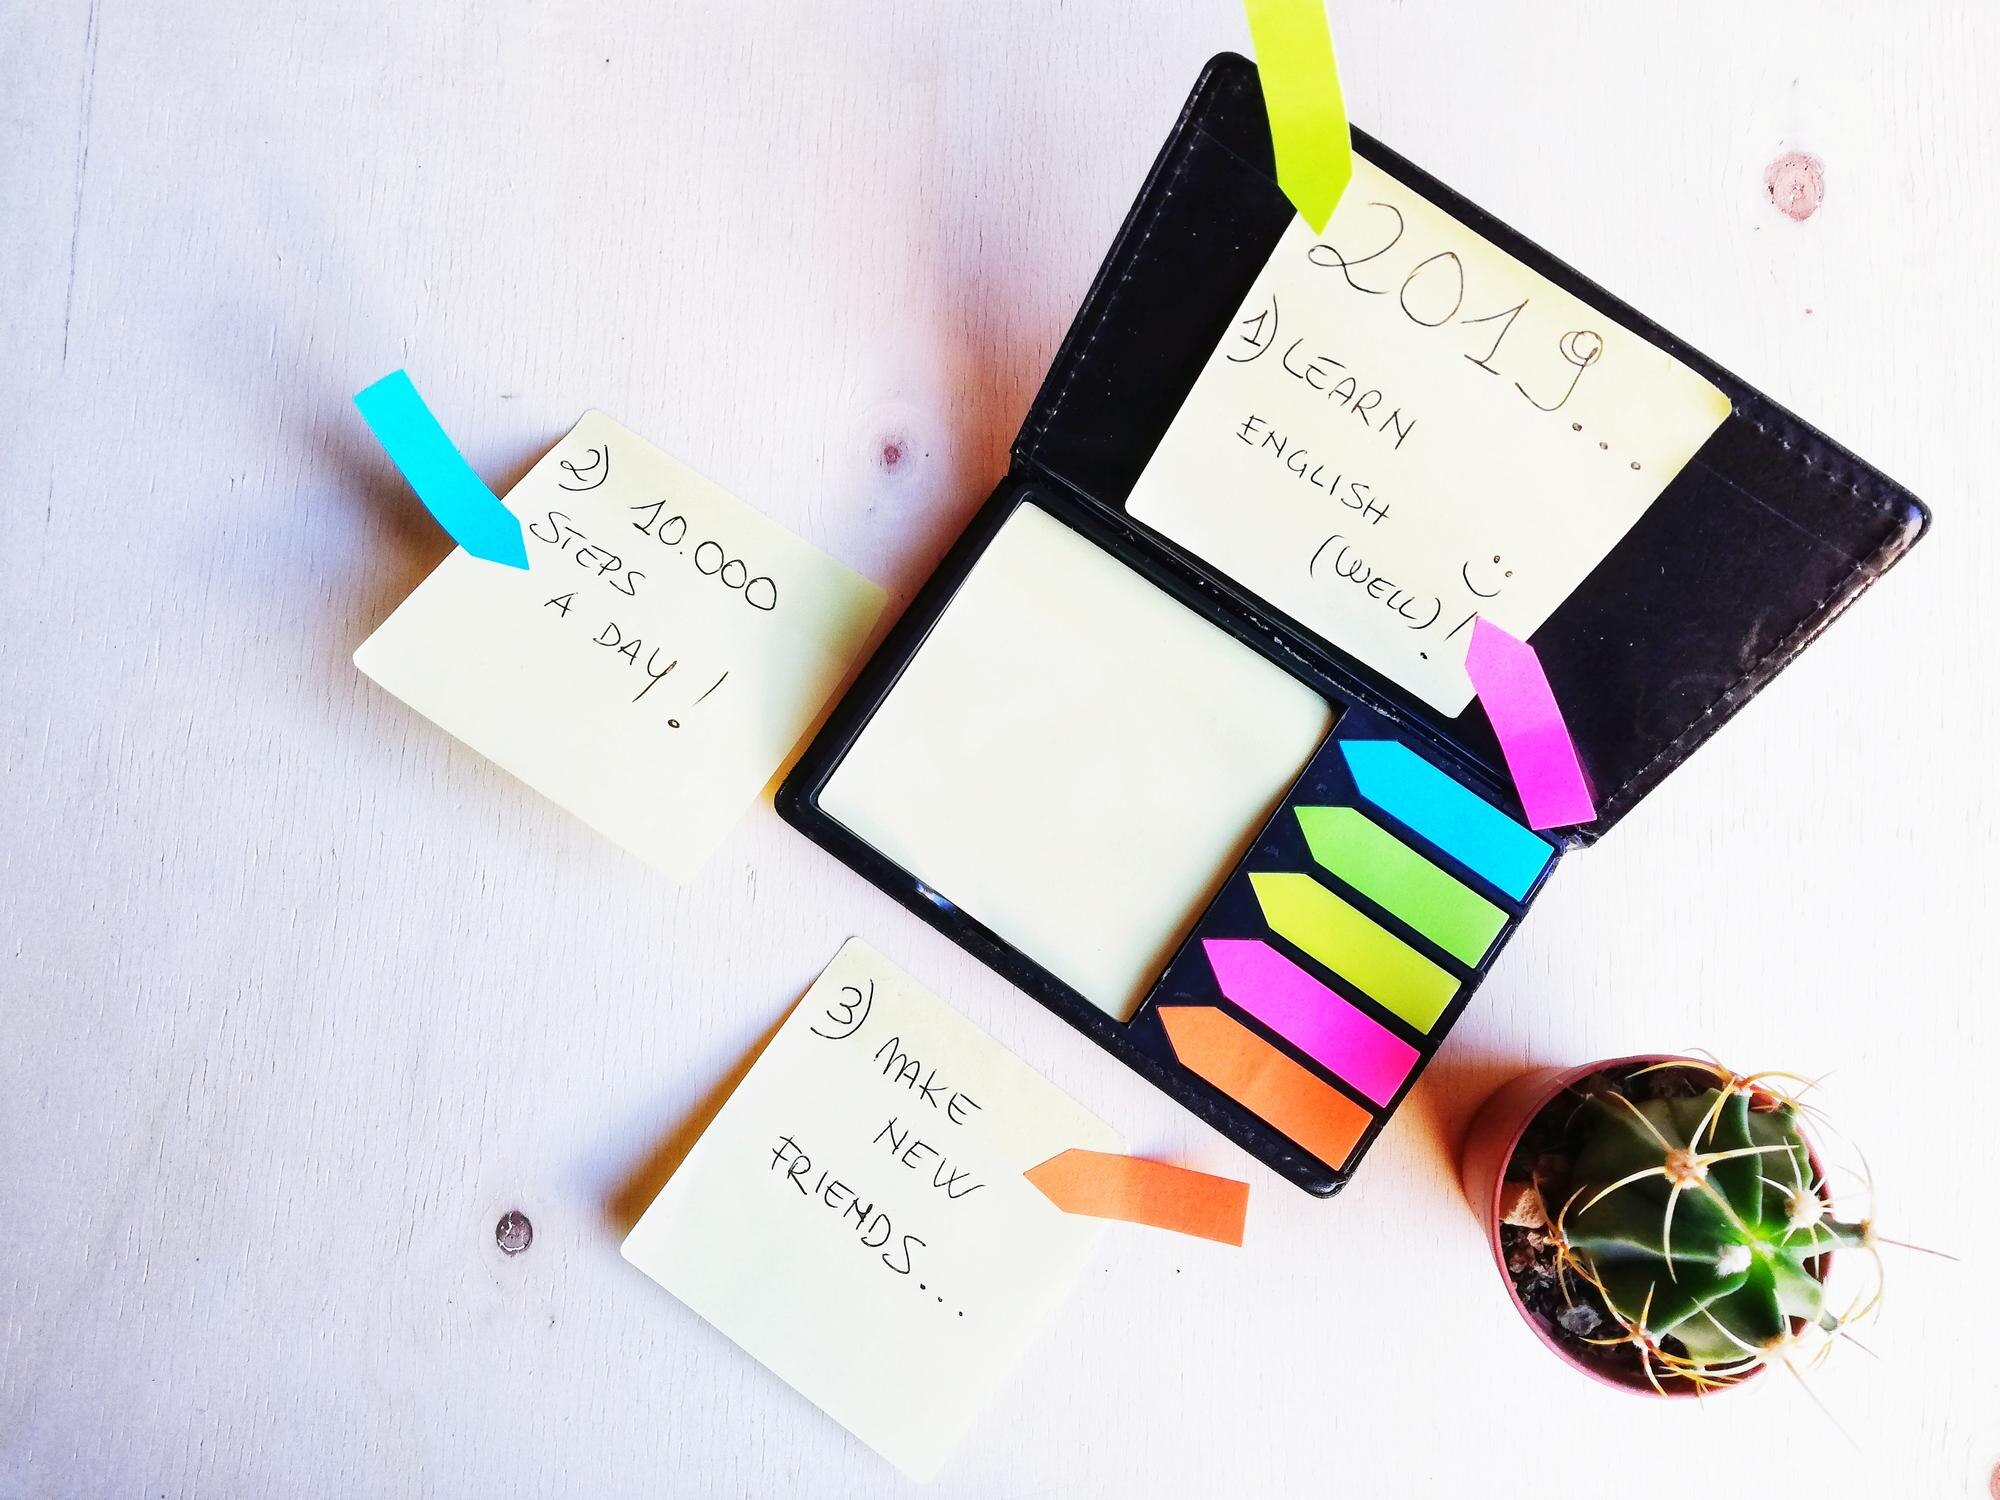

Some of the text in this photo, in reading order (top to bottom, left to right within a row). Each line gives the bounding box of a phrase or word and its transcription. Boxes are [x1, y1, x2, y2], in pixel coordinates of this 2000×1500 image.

[1307, 202, 1642, 471] 2019...
[1282, 338, 1419, 449] LEARN
[1235, 413, 1391, 525] ENGLISH
[529, 511, 647, 597] STEPS
[558, 444, 778, 611] 2) 10.000
[543, 591, 579, 618] A
[809, 978, 983, 1126] 3) MAKE
[872, 1116, 987, 1199] NEW
